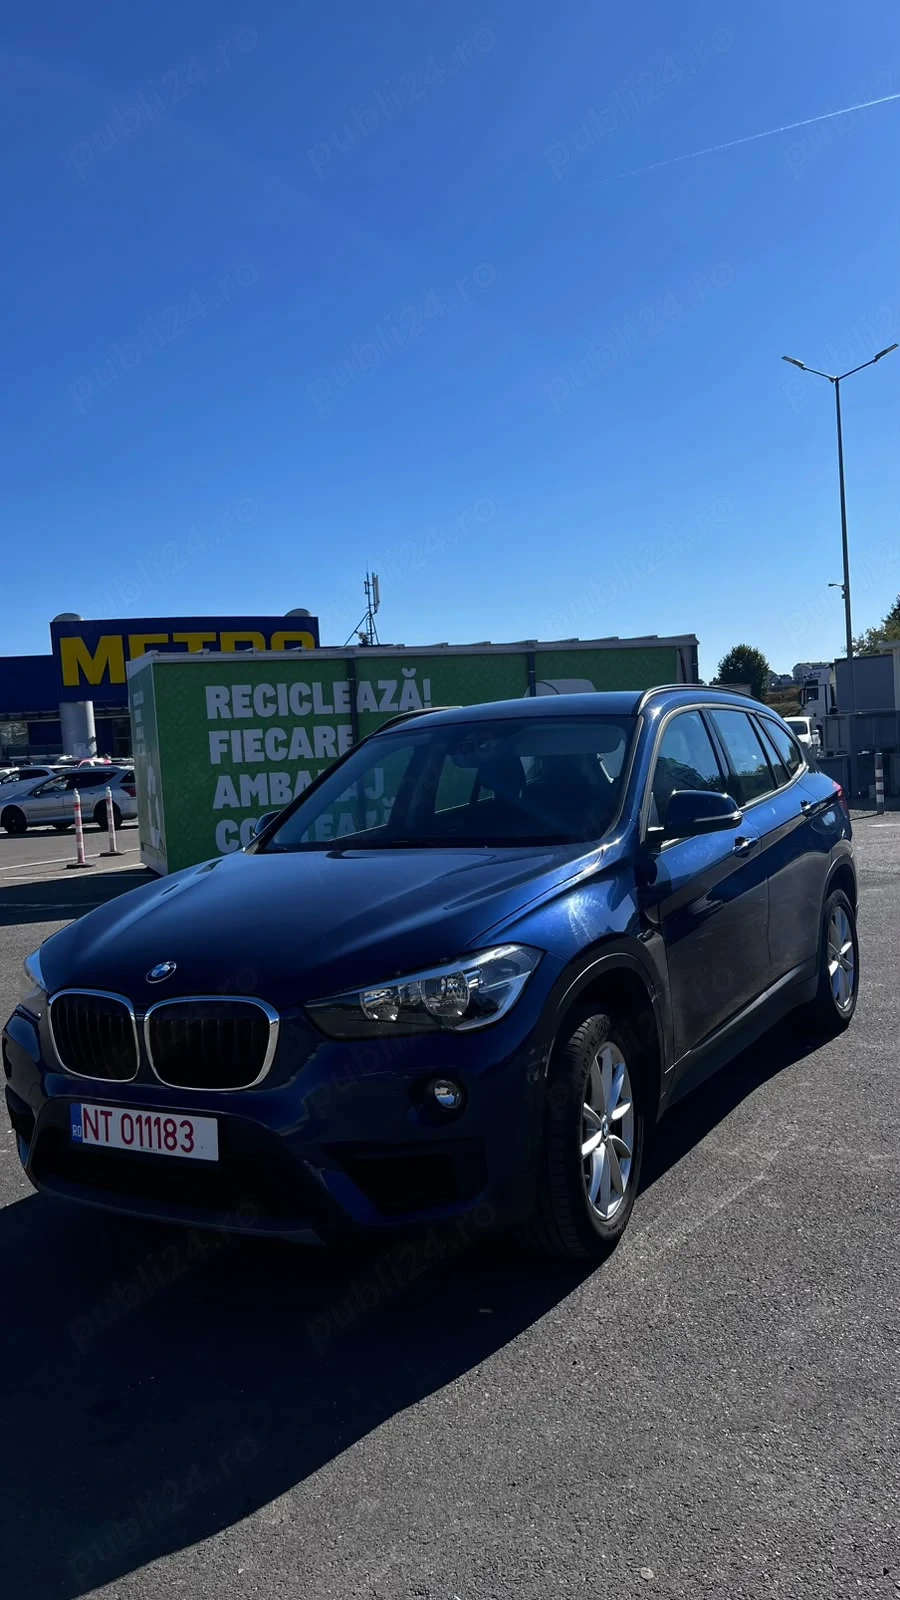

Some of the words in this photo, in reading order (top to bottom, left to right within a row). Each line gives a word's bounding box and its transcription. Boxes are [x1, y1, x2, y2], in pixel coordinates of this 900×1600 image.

[205, 667, 432, 720] RECICLEAZĂ!
[208, 724, 354, 765] FIECARE
[213, 767, 385, 810] AMBAJ
[72, 1124, 82, 1138] RO
[83, 1108, 112, 1143] NT
[121, 1113, 195, 1153] 011183
